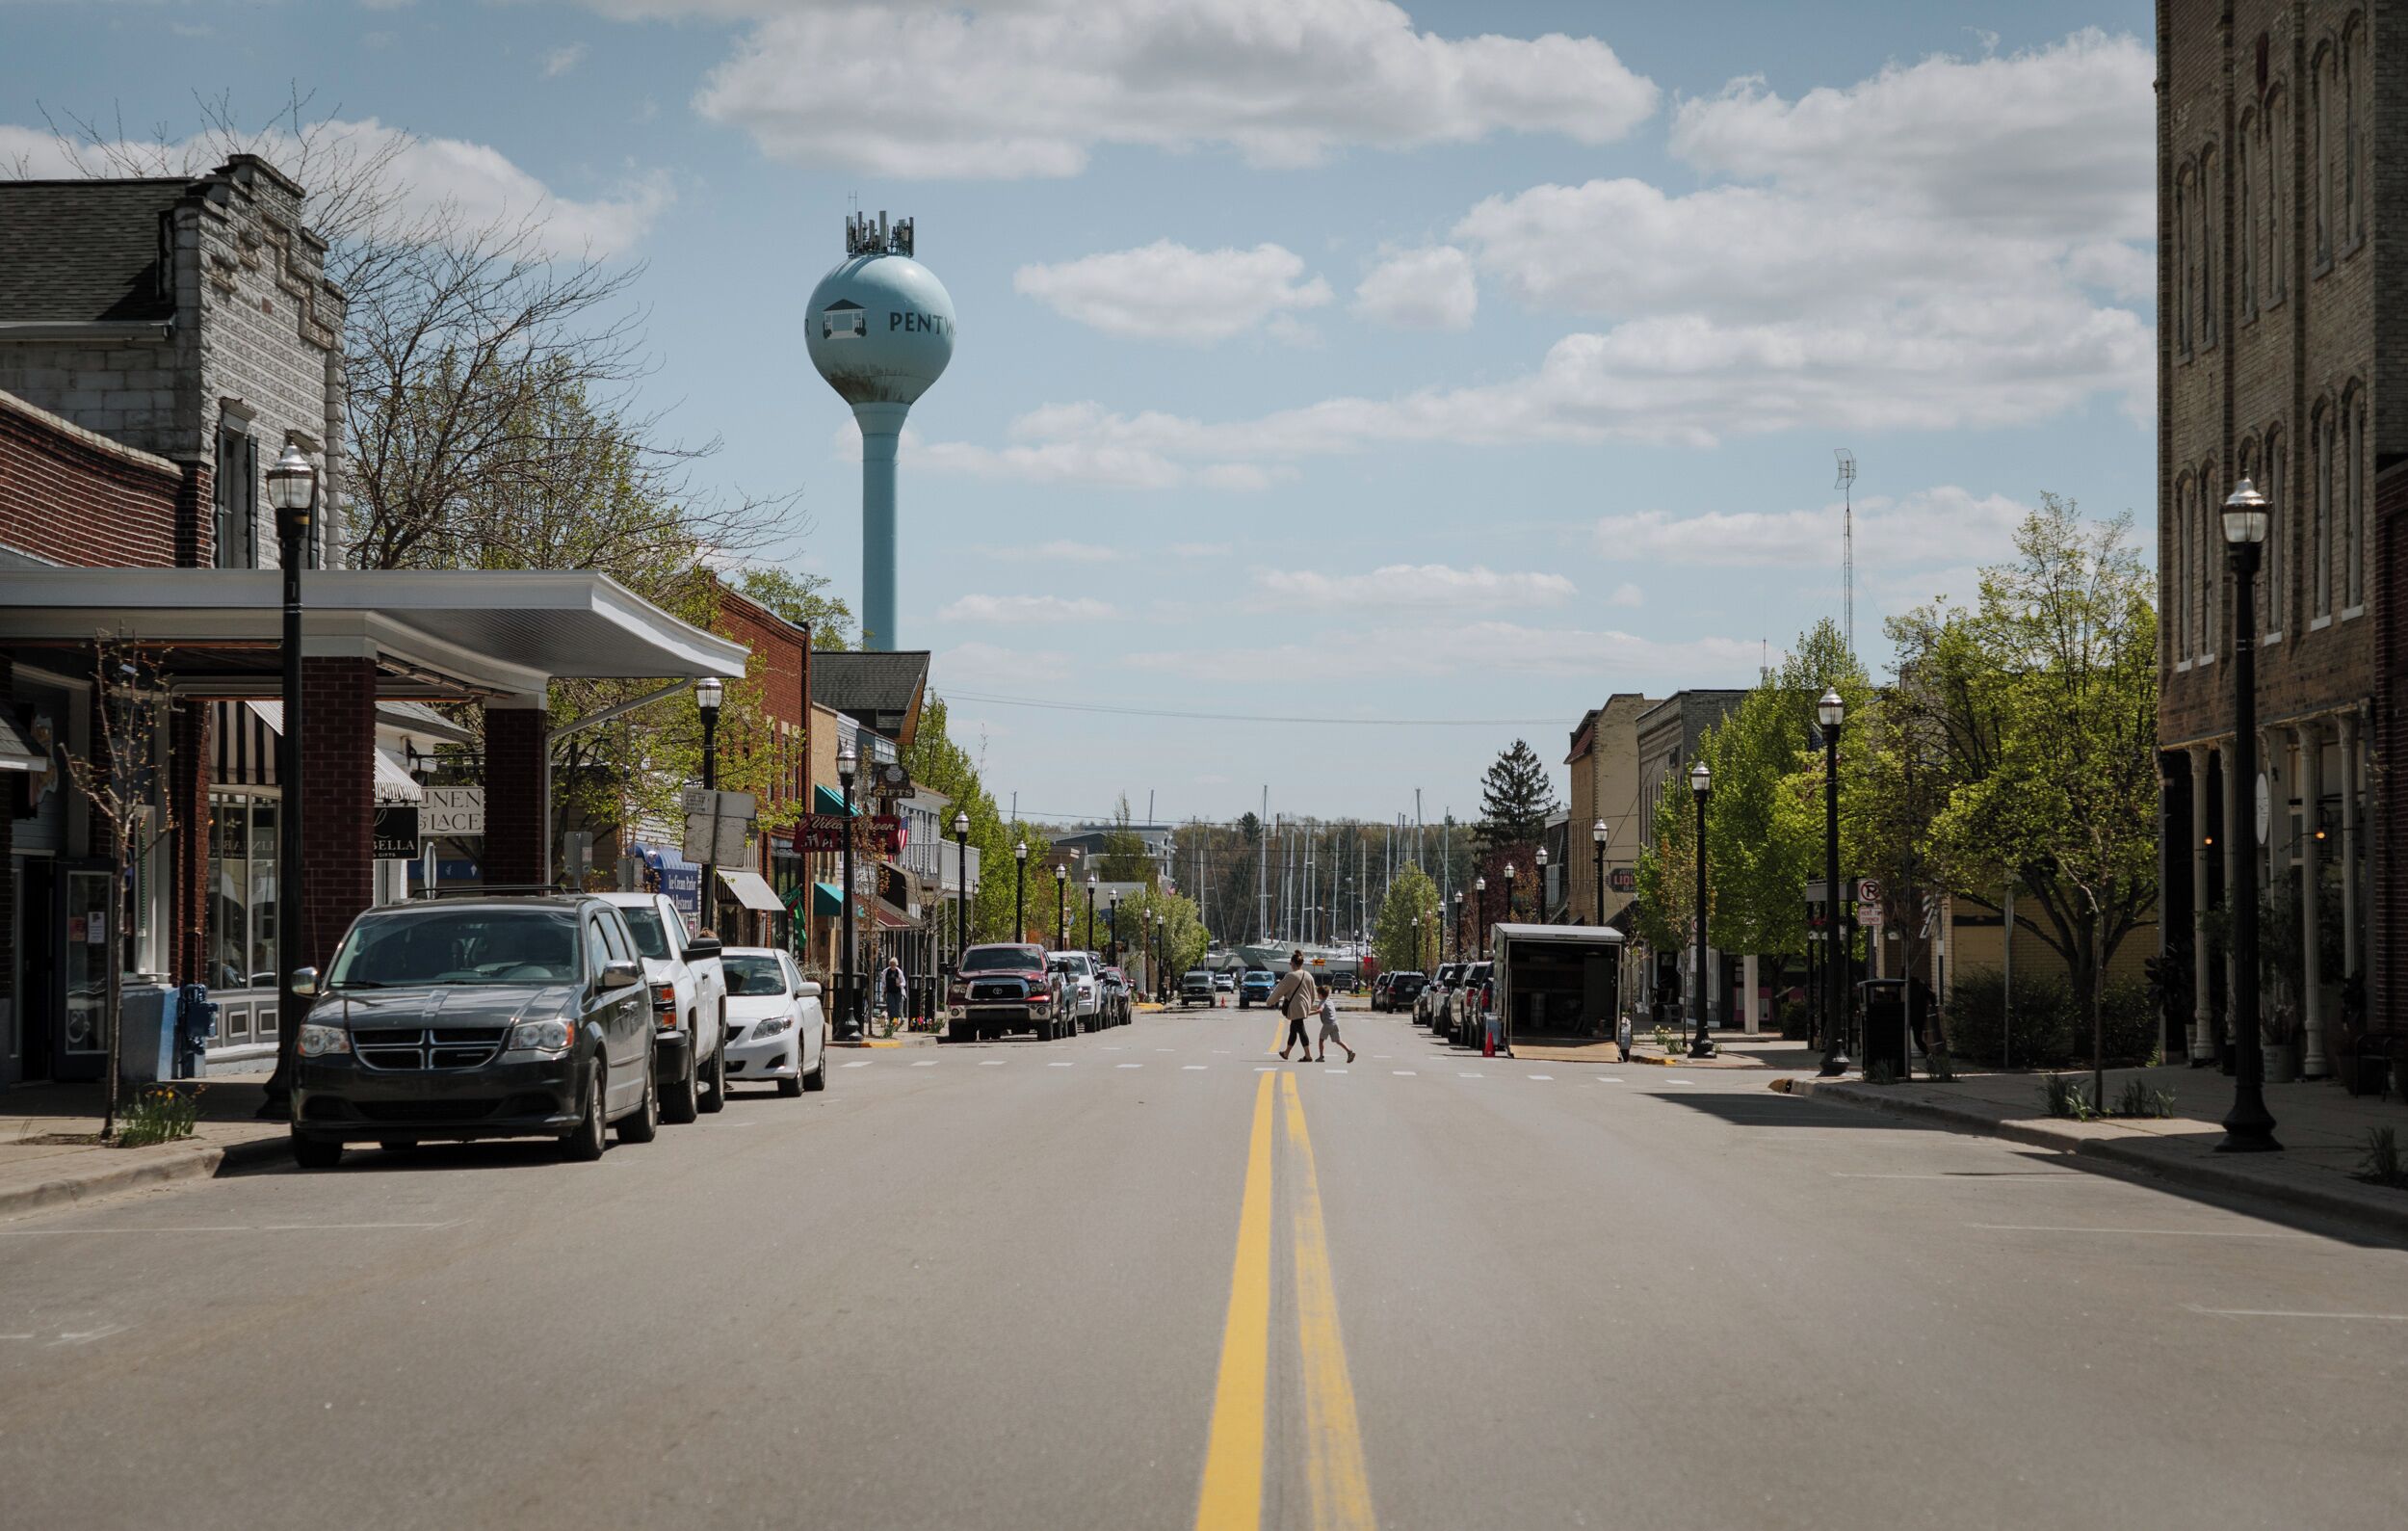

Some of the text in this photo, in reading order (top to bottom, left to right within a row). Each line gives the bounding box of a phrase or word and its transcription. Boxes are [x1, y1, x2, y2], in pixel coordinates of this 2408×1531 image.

[890, 311, 956, 338] PENTW
[419, 790, 482, 808] INEN
[431, 813, 482, 831] LACE
[674, 875, 686, 890] Cream
